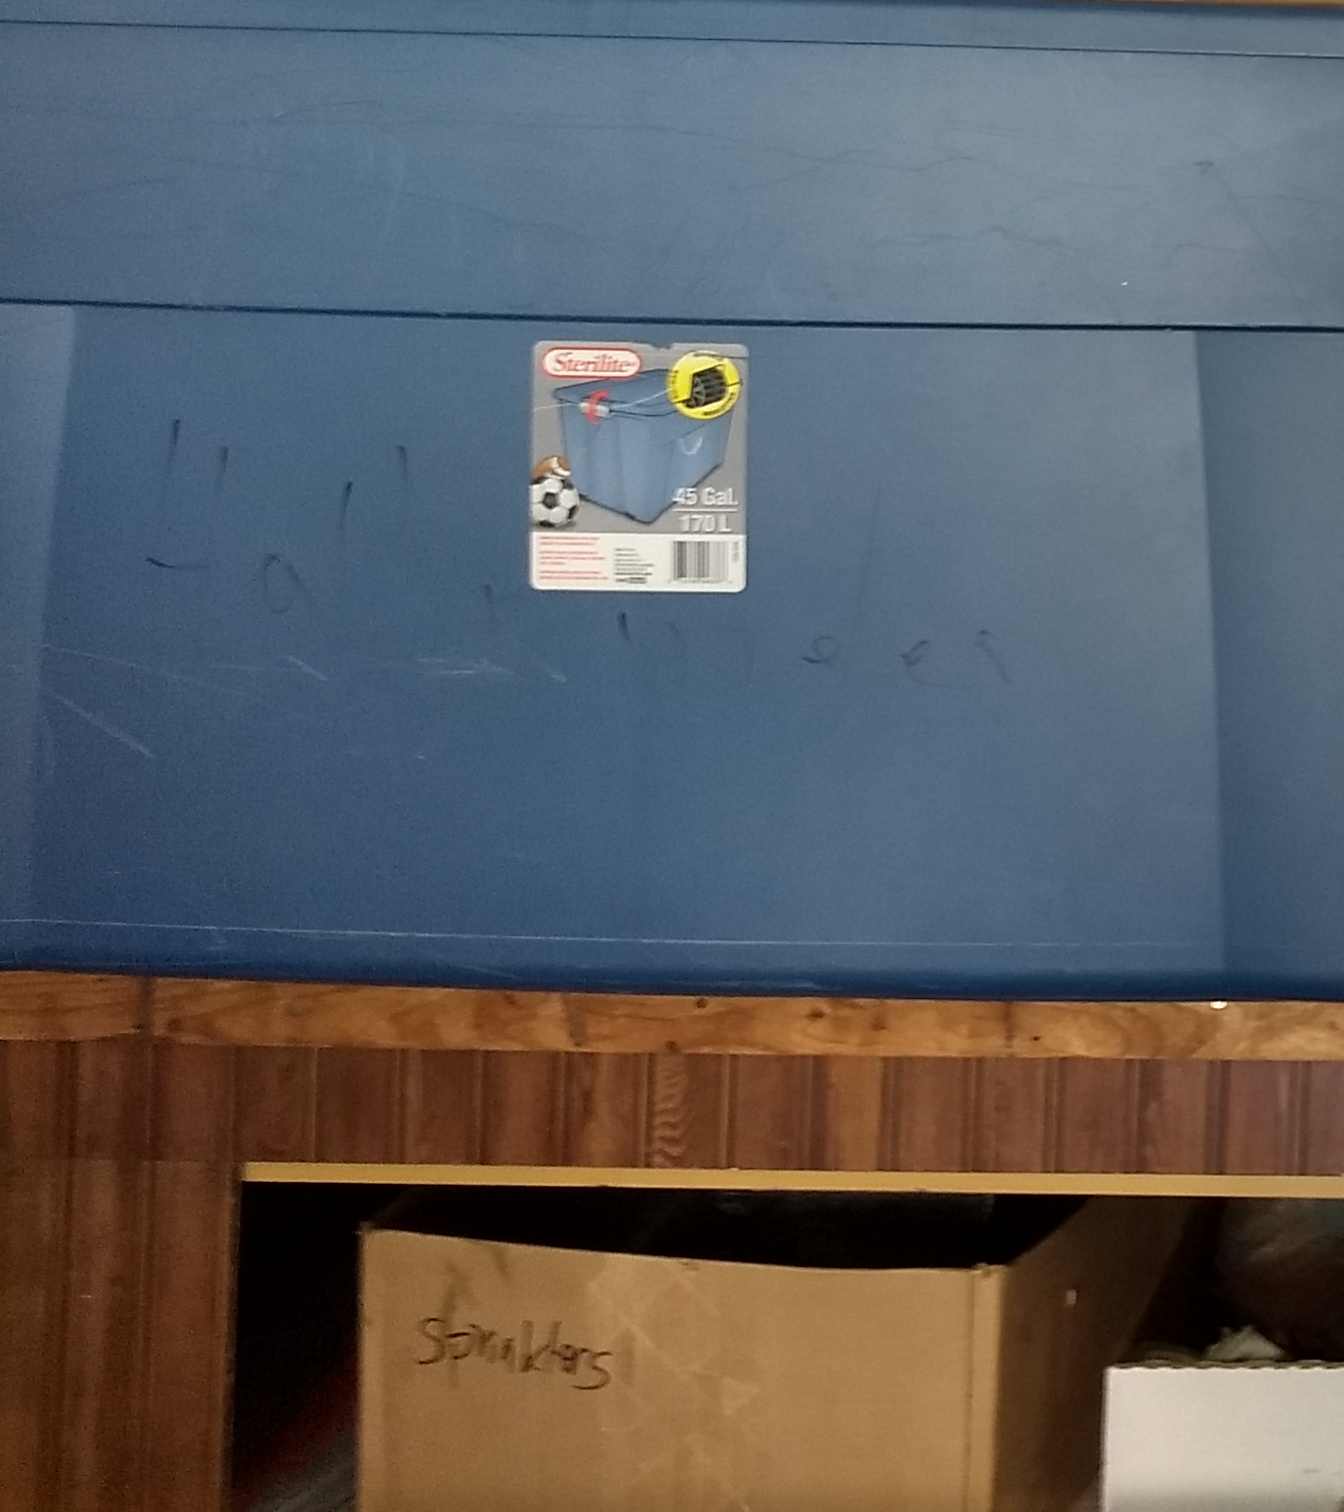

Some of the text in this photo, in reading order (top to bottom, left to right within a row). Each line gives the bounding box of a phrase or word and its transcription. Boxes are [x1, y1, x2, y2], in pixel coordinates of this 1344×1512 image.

[553, 350, 632, 374] Sterilite
[672, 487, 699, 506] 45
[679, 514, 733, 534] 170 L
